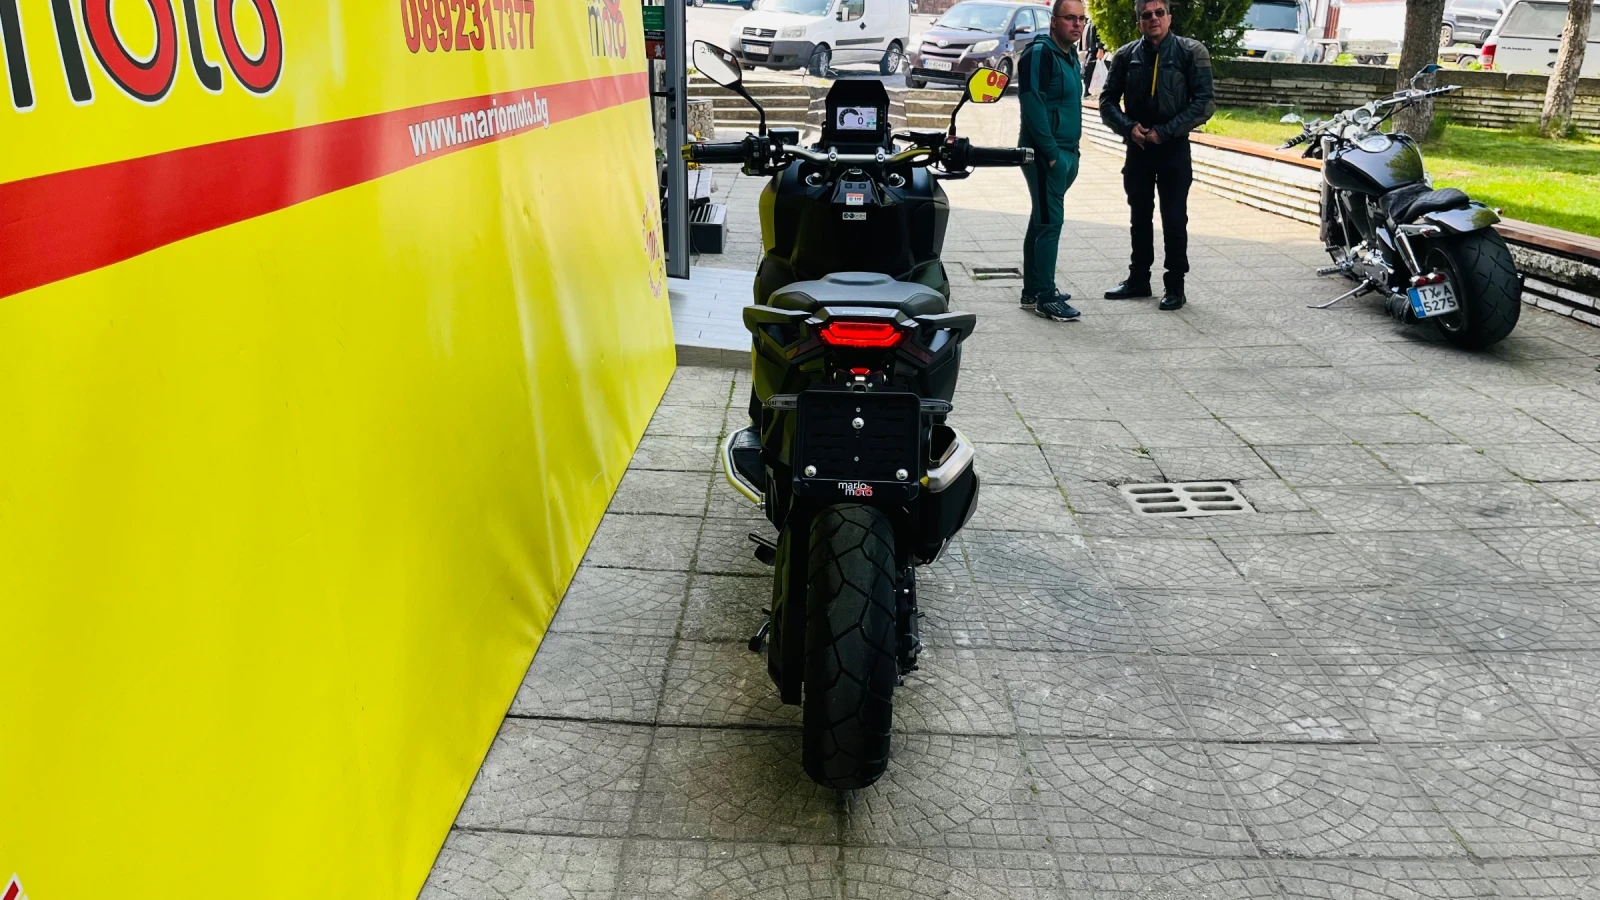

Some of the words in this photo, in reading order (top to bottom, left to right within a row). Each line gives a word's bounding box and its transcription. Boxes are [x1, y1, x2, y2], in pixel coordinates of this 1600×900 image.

[399, 0, 535, 53] 0892317377
[587, 5, 627, 60] moto
[408, 91, 549, 157] www.mariomoto.bg
[857, 116, 864, 125] 0
[1419, 286, 1438, 300] TX
[1443, 284, 1452, 296] A
[1423, 296, 1456, 312] 5275
[838, 481, 867, 490] mario
[845, 488, 873, 497] moto
